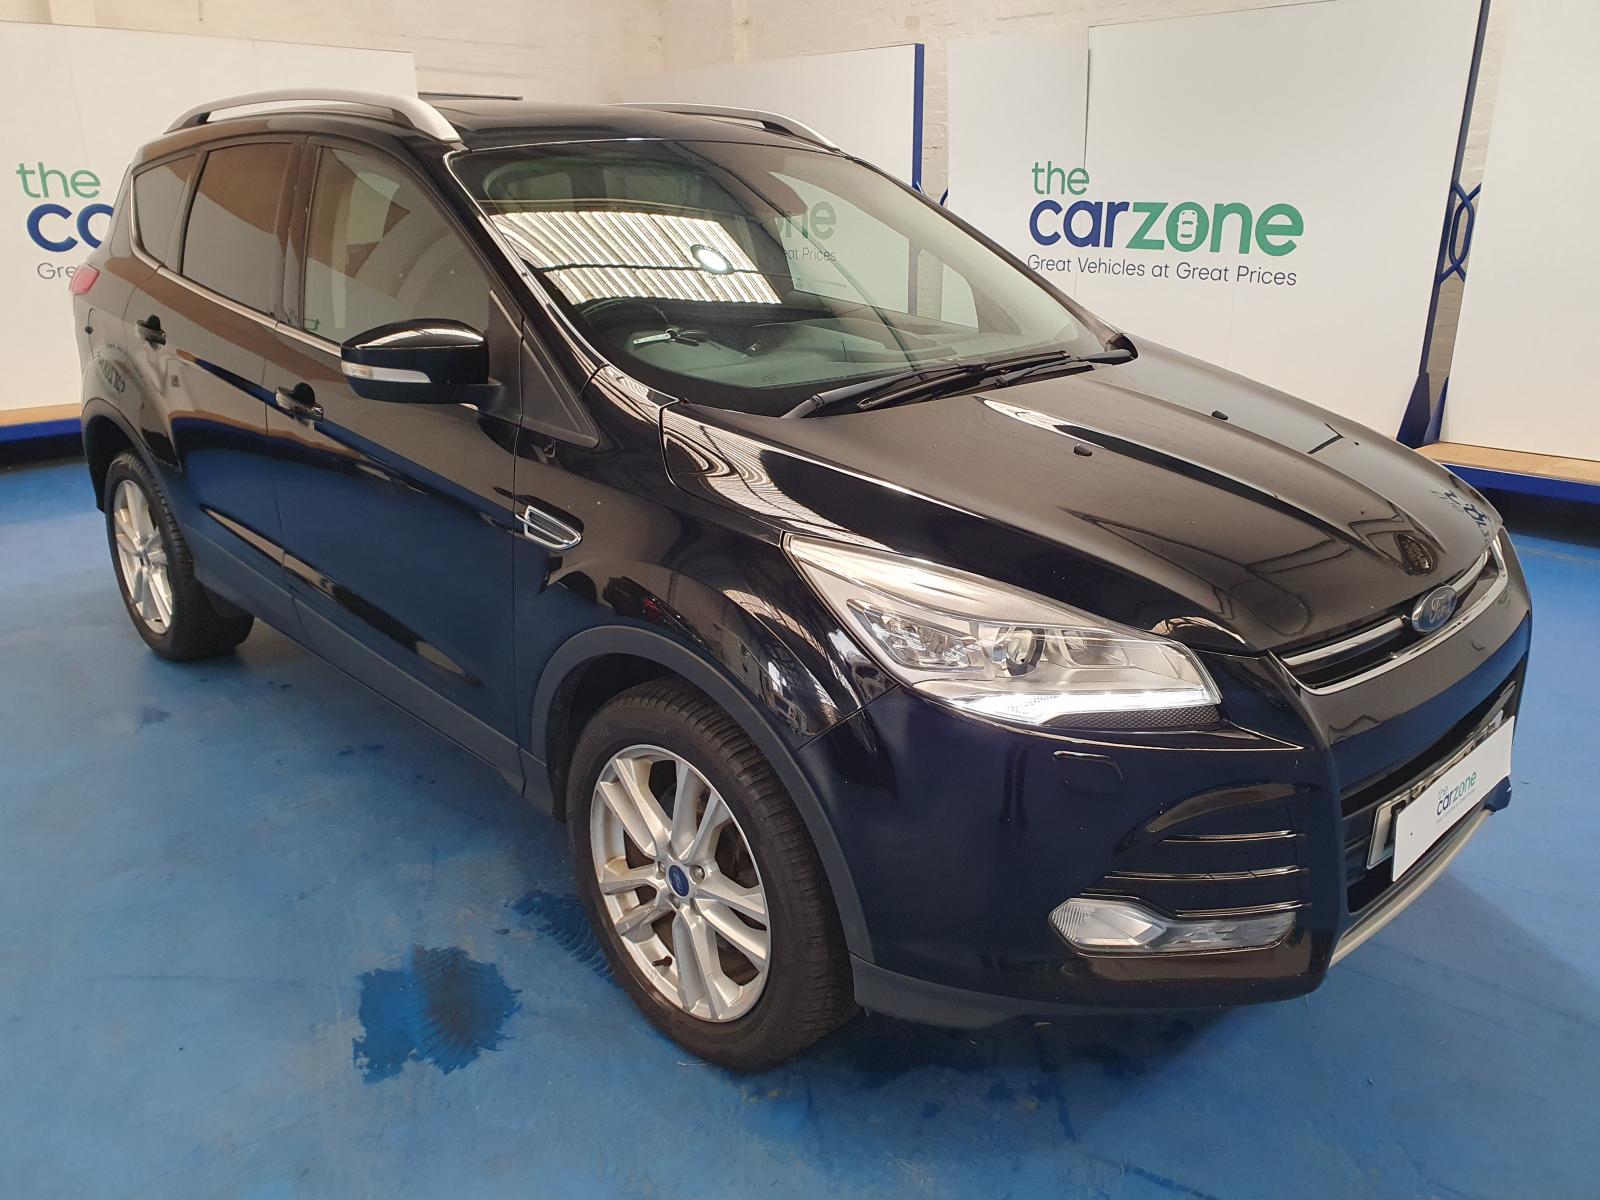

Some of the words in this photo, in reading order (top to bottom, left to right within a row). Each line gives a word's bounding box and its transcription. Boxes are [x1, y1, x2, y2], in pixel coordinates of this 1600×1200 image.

[16, 162, 101, 198] the
[1031, 160, 1091, 196] the
[1029, 199, 1305, 257] carzone
[802, 247, 837, 262] Prices
[1027, 254, 1072, 272] Great
[1078, 256, 1146, 277] Vehicles
[1151, 263, 1169, 278] at
[1176, 261, 1230, 282] Great
[1237, 265, 1297, 286] Prices
[1436, 771, 1477, 816] carzone
